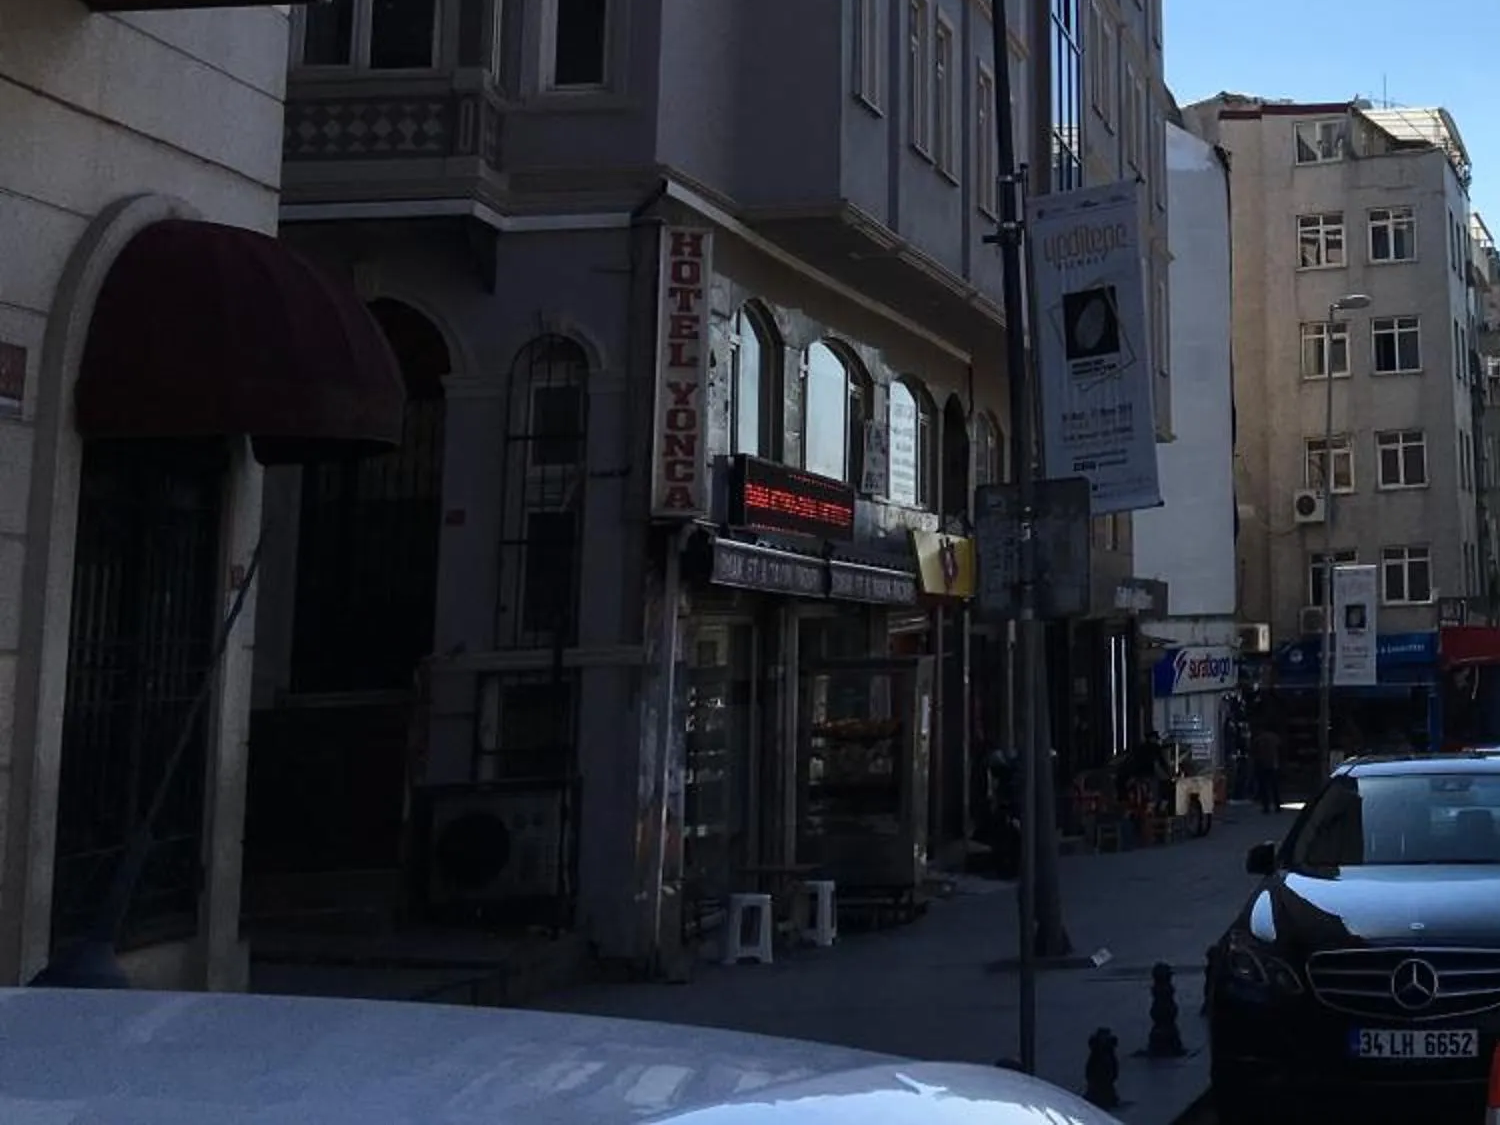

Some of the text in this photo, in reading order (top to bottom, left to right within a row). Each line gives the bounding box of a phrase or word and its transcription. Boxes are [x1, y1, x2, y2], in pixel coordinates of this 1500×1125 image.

[661, 231, 704, 510] HOTEL YONCA
[1361, 1032, 1473, 1056] 34 LH 6652
